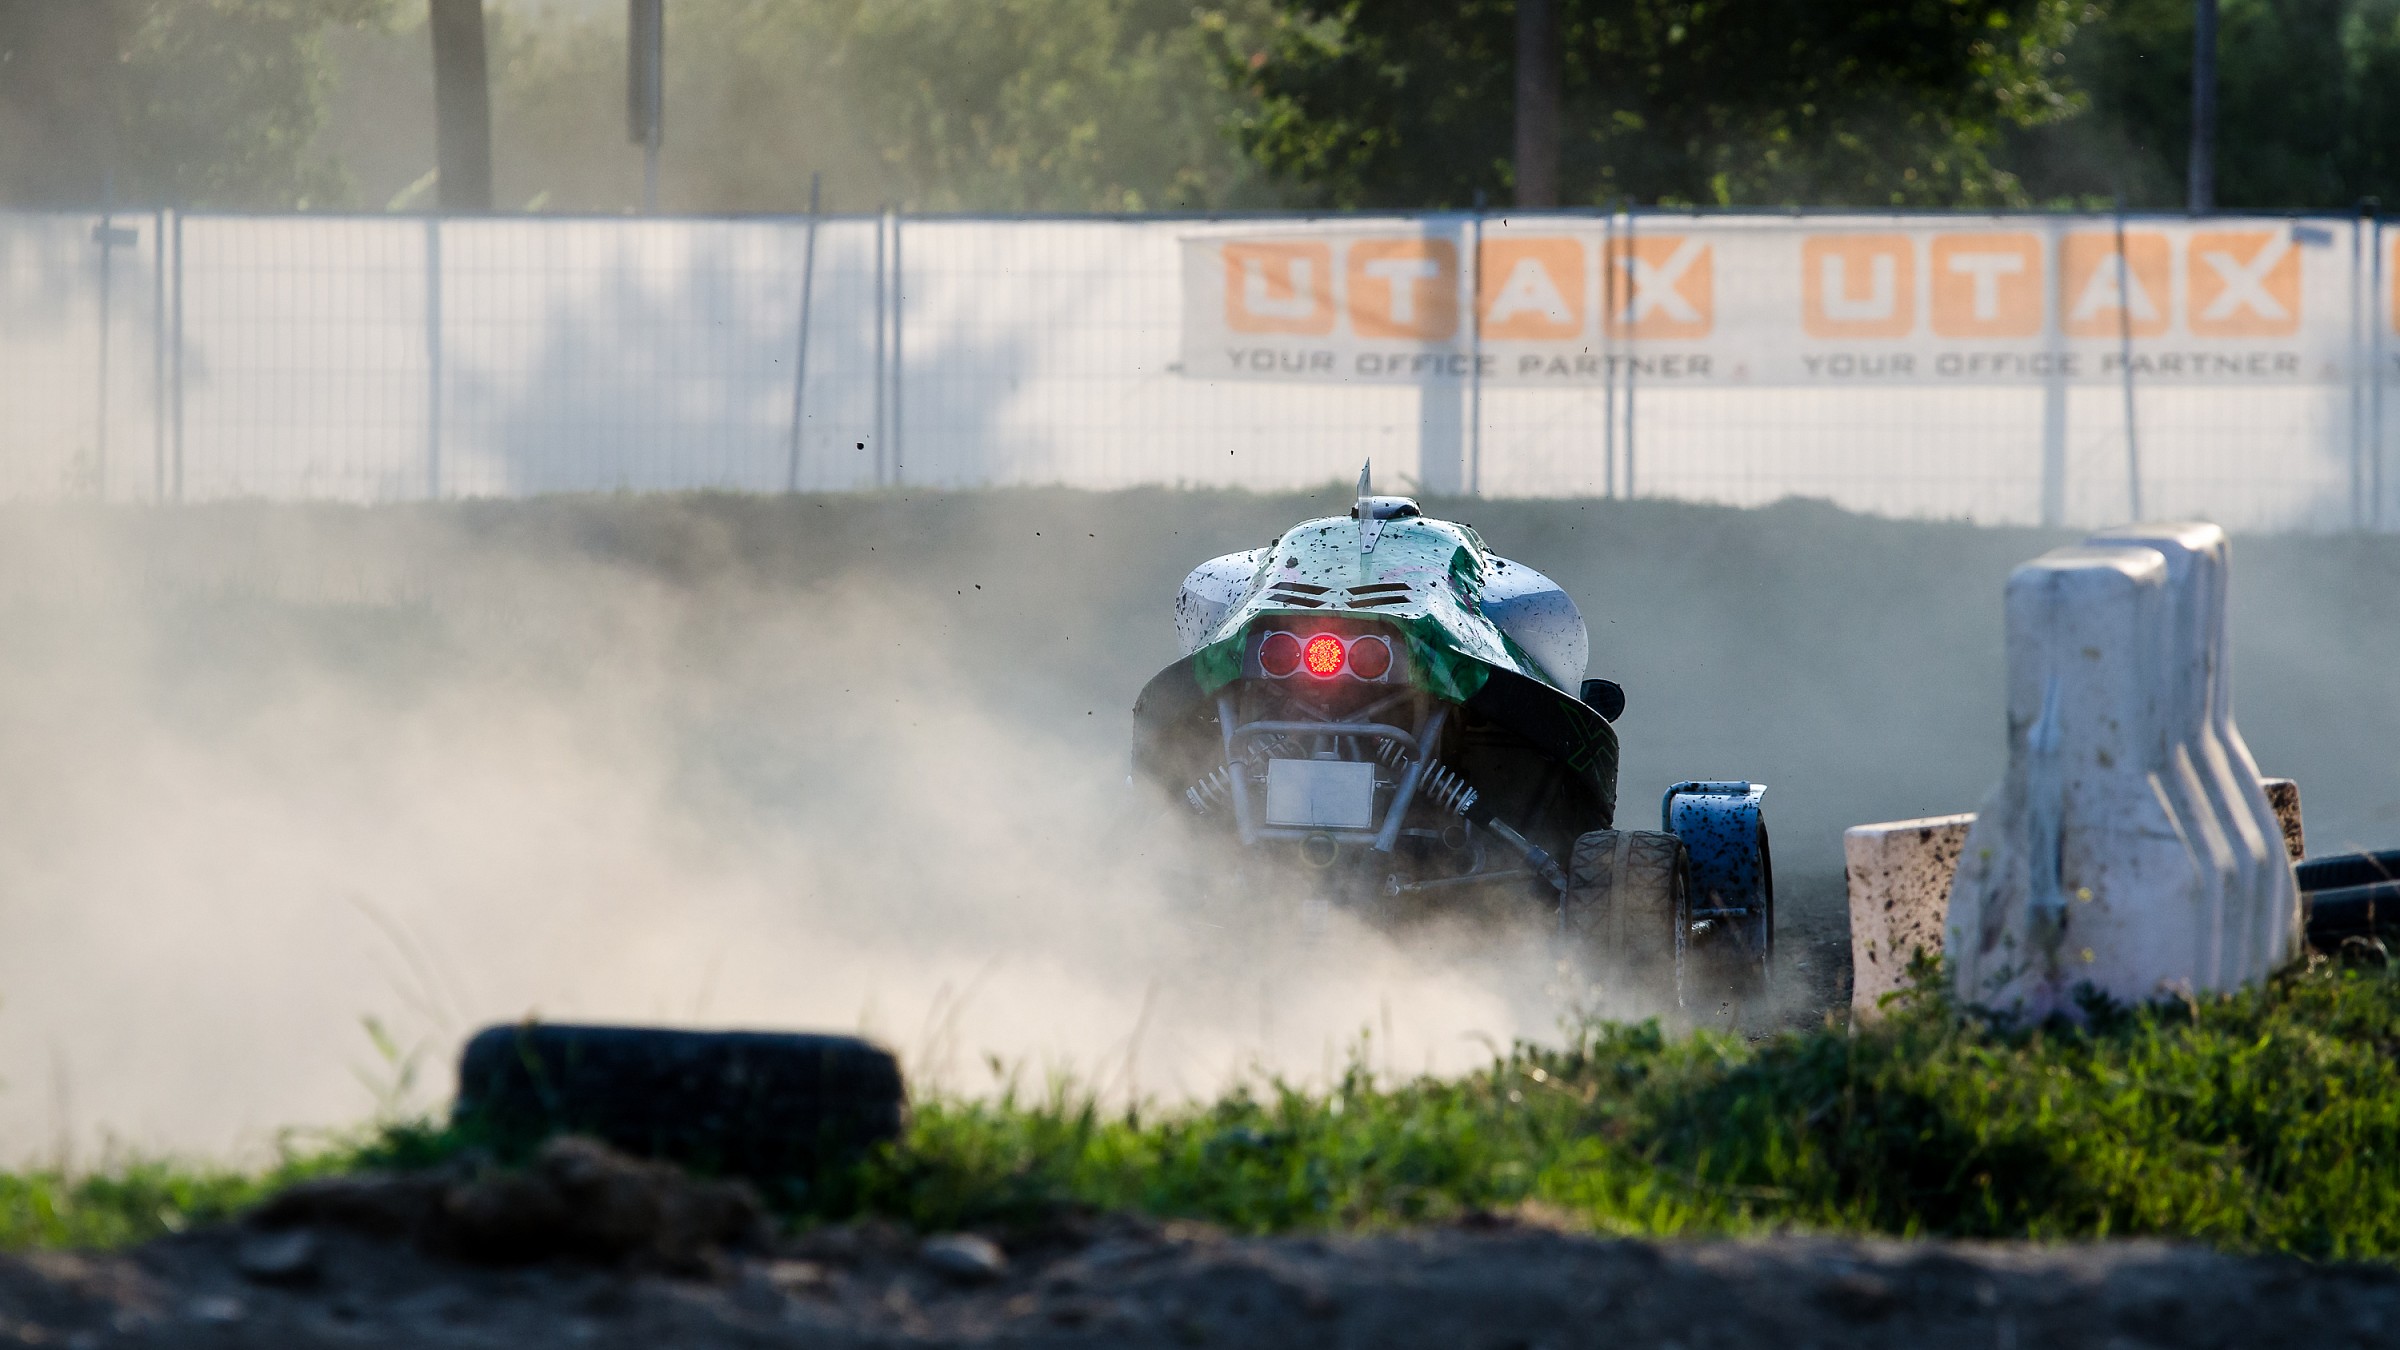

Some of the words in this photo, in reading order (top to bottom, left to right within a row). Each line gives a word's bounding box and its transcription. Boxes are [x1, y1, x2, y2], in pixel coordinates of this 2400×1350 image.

[1238, 238, 1711, 328] UTAX
[1822, 233, 2300, 323] UTAX
[1228, 348, 1334, 375] YOUR
[1357, 353, 1495, 377] OFFICE
[1519, 353, 1713, 377] PARTNER
[1803, 352, 1915, 376] YOUR
[1938, 352, 2081, 377] OFFICE
[2102, 353, 2300, 376] PARTNER
